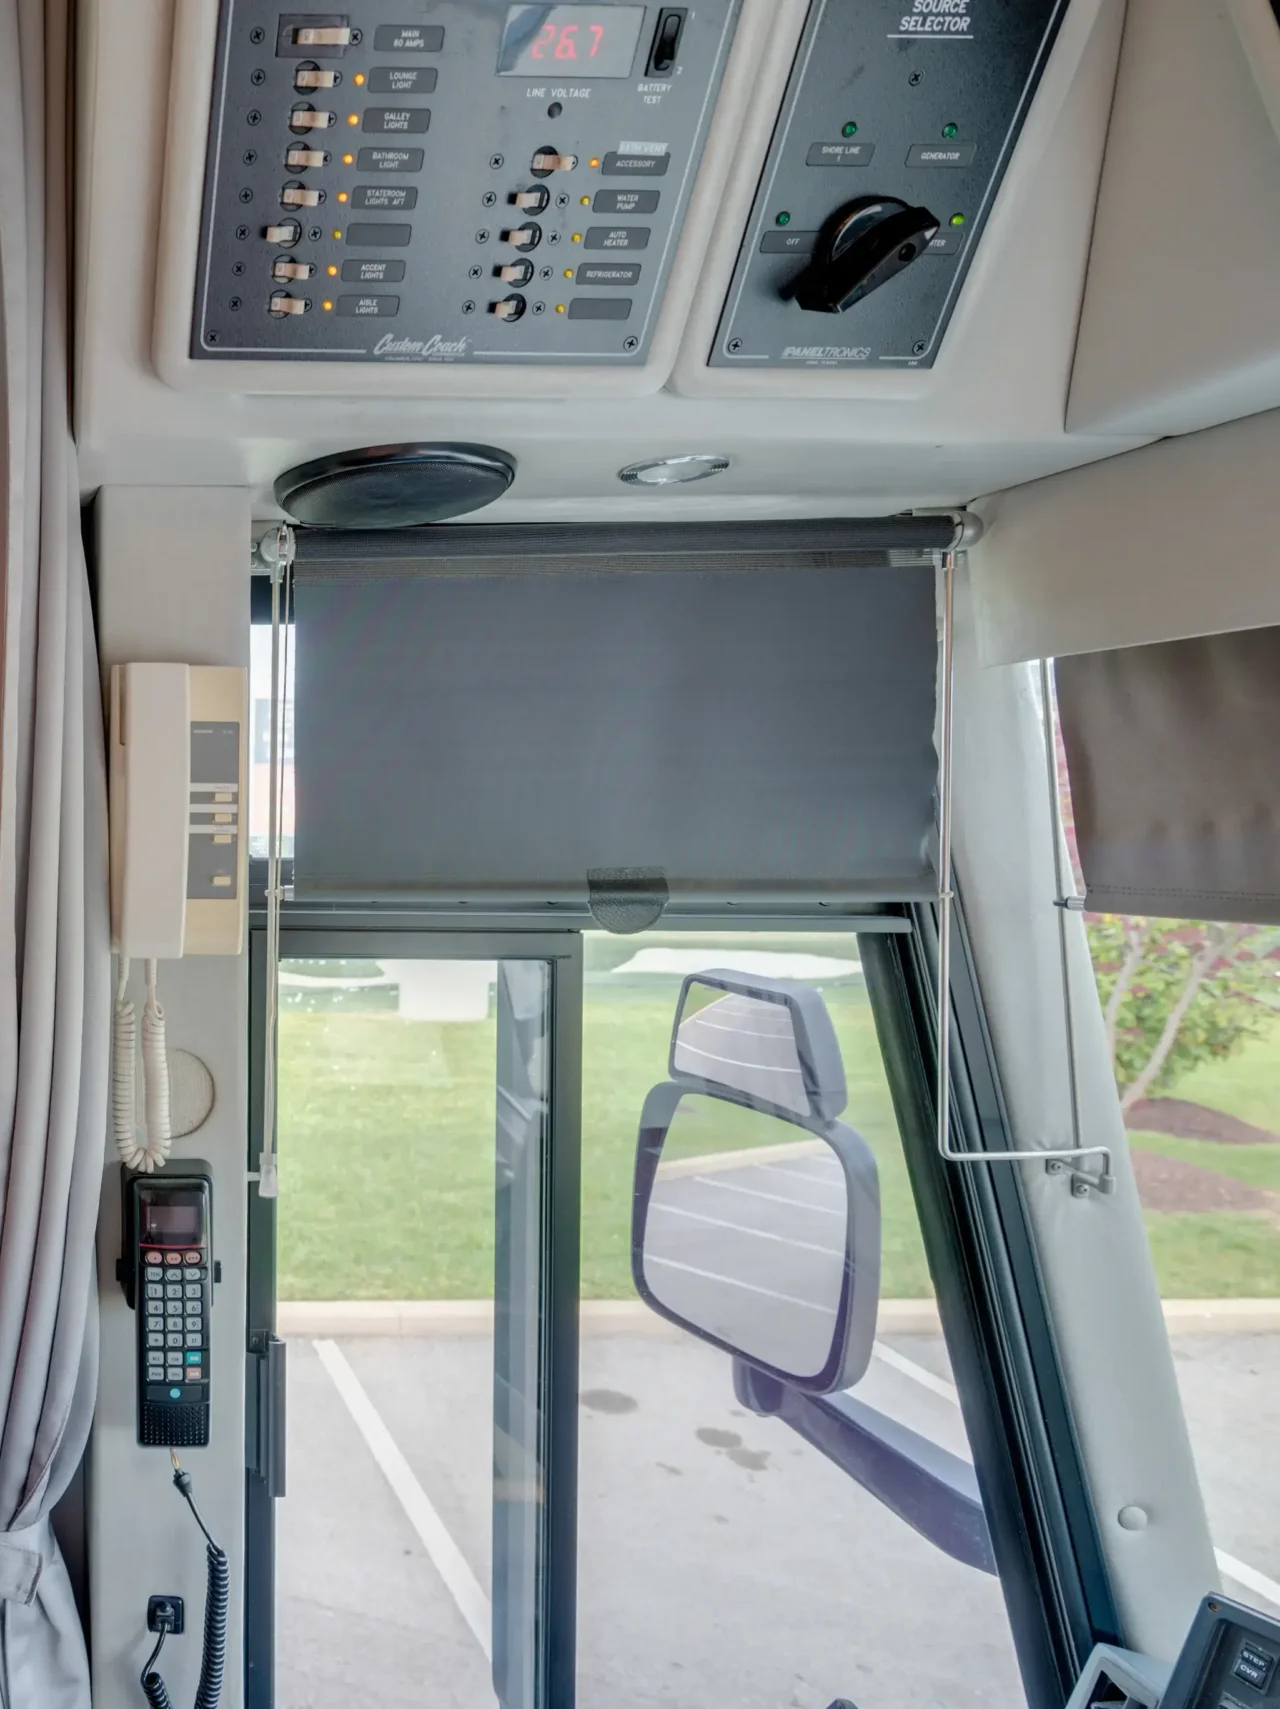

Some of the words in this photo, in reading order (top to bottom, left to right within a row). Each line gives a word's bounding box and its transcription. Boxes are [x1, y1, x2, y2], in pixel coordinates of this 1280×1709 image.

[912, 0, 970, 13] SOURCE
[899, 16, 971, 31] SELECTOR
[401, 30, 420, 38] MAIN
[405, 39, 424, 48] AMPS
[389, 71, 418, 80] LOUNGE
[391, 81, 413, 89] LIGHT
[637, 83, 672, 93] BATTERY
[526, 88, 546, 98] LINE
[551, 88, 592, 99] VOLTAGE
[643, 95, 662, 104] TEST
[384, 112, 410, 121] GALLEY
[383, 121, 409, 130] LIGHTS
[822, 146, 844, 154] SHORE
[845, 146, 861, 154] LINE
[372, 151, 409, 161] BATHROOM
[920, 152, 960, 161] GENERATOR
[379, 161, 400, 169] LIGHT
[615, 159, 656, 168] ACCESSORY
[366, 189, 406, 198] STATEROOM
[617, 194, 639, 202] WATER
[365, 198, 389, 206] LIGHTS
[616, 202, 636, 210] PUMP
[609, 231, 627, 239] AUTO
[603, 239, 629, 247] HEATER
[786, 238, 800, 246] OFF
[361, 264, 386, 272] ACCENT
[360, 271, 384, 279] LIGHTS
[586, 270, 633, 279] REFRIGERATOR
[358, 299, 378, 307] AISLE
[355, 306, 379, 314] LIGHTS
[373, 333, 423, 355] Custom
[421, 334, 467, 356] Coach
